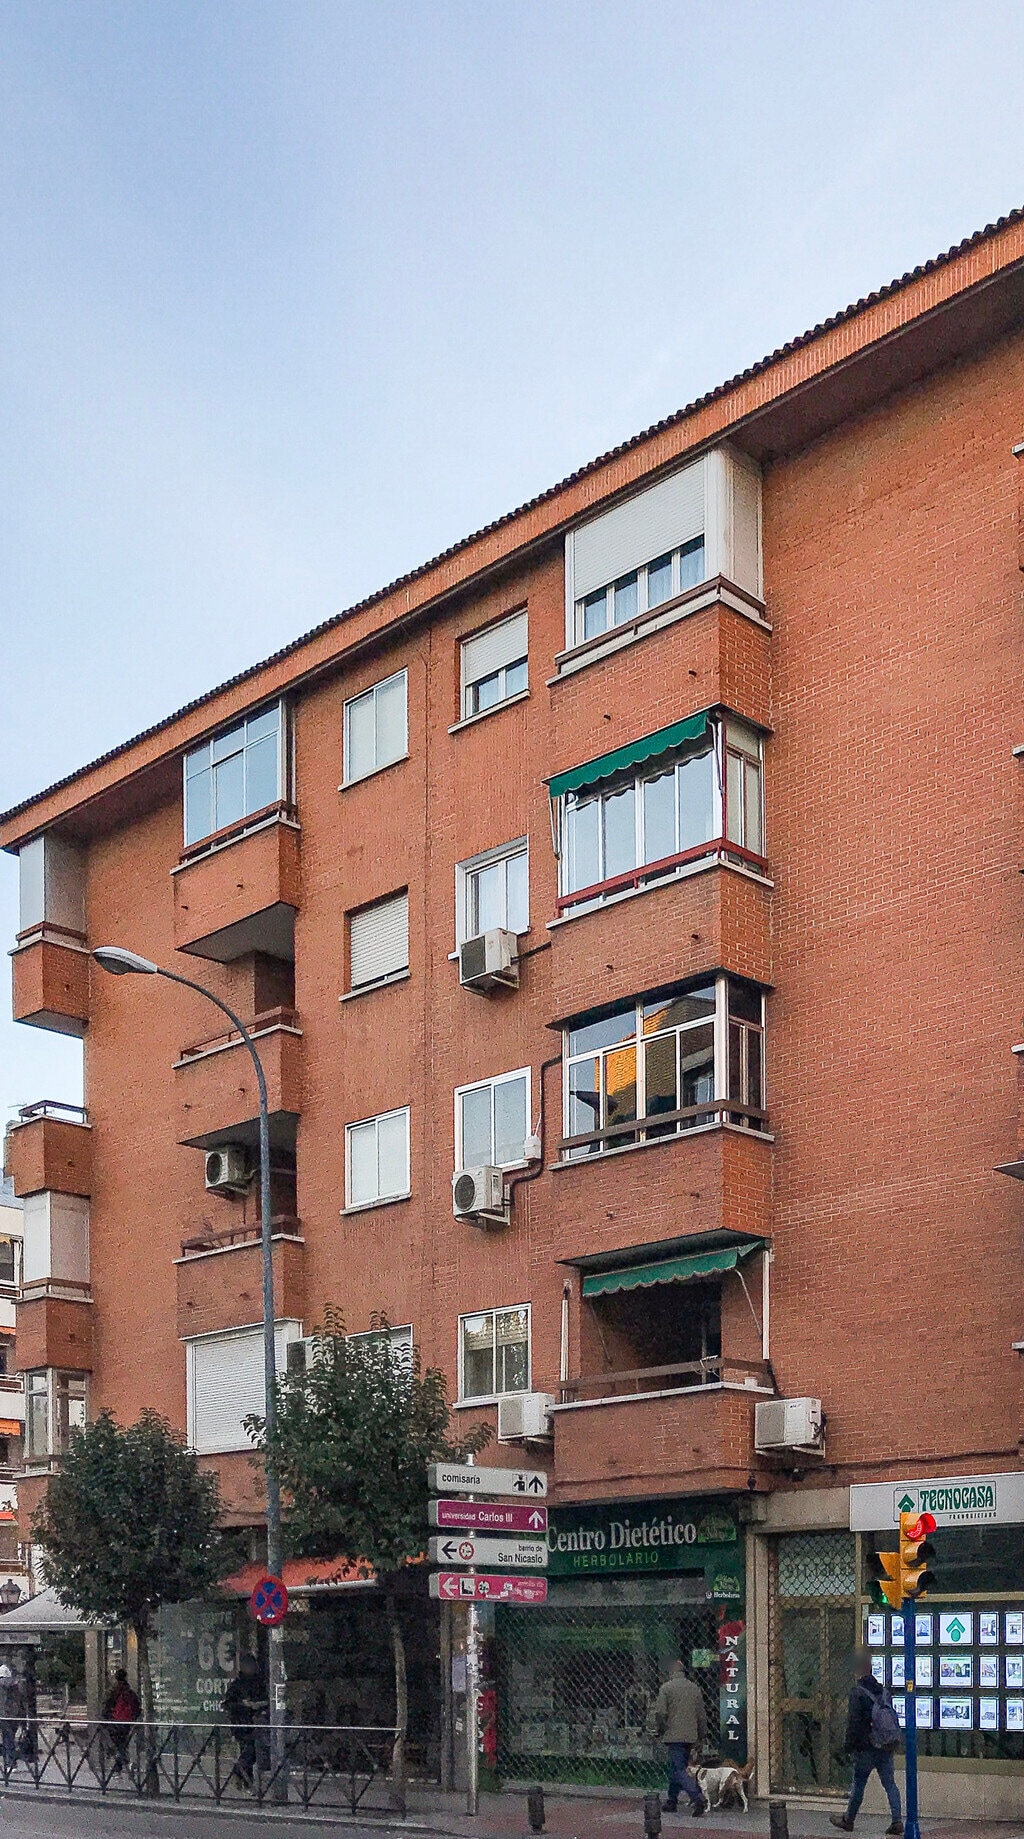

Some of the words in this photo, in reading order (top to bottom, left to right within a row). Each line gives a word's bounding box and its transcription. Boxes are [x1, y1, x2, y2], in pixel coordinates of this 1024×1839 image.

[441, 1473, 481, 1485] comisaría
[920, 1486, 994, 1511] TECNOCASA
[441, 1512, 476, 1521] universidad
[478, 1511, 504, 1523] Carlos
[505, 1513, 513, 1523] III
[545, 1526, 606, 1552] Centro
[609, 1514, 697, 1549] Dietético
[518, 1544, 535, 1553] barrio
[536, 1545, 543, 1553] de
[497, 1552, 513, 1563] San
[514, 1553, 543, 1564] Nicasio
[573, 1551, 659, 1567] HERBOLARIO
[725, 1635, 740, 1741] NATURAL
